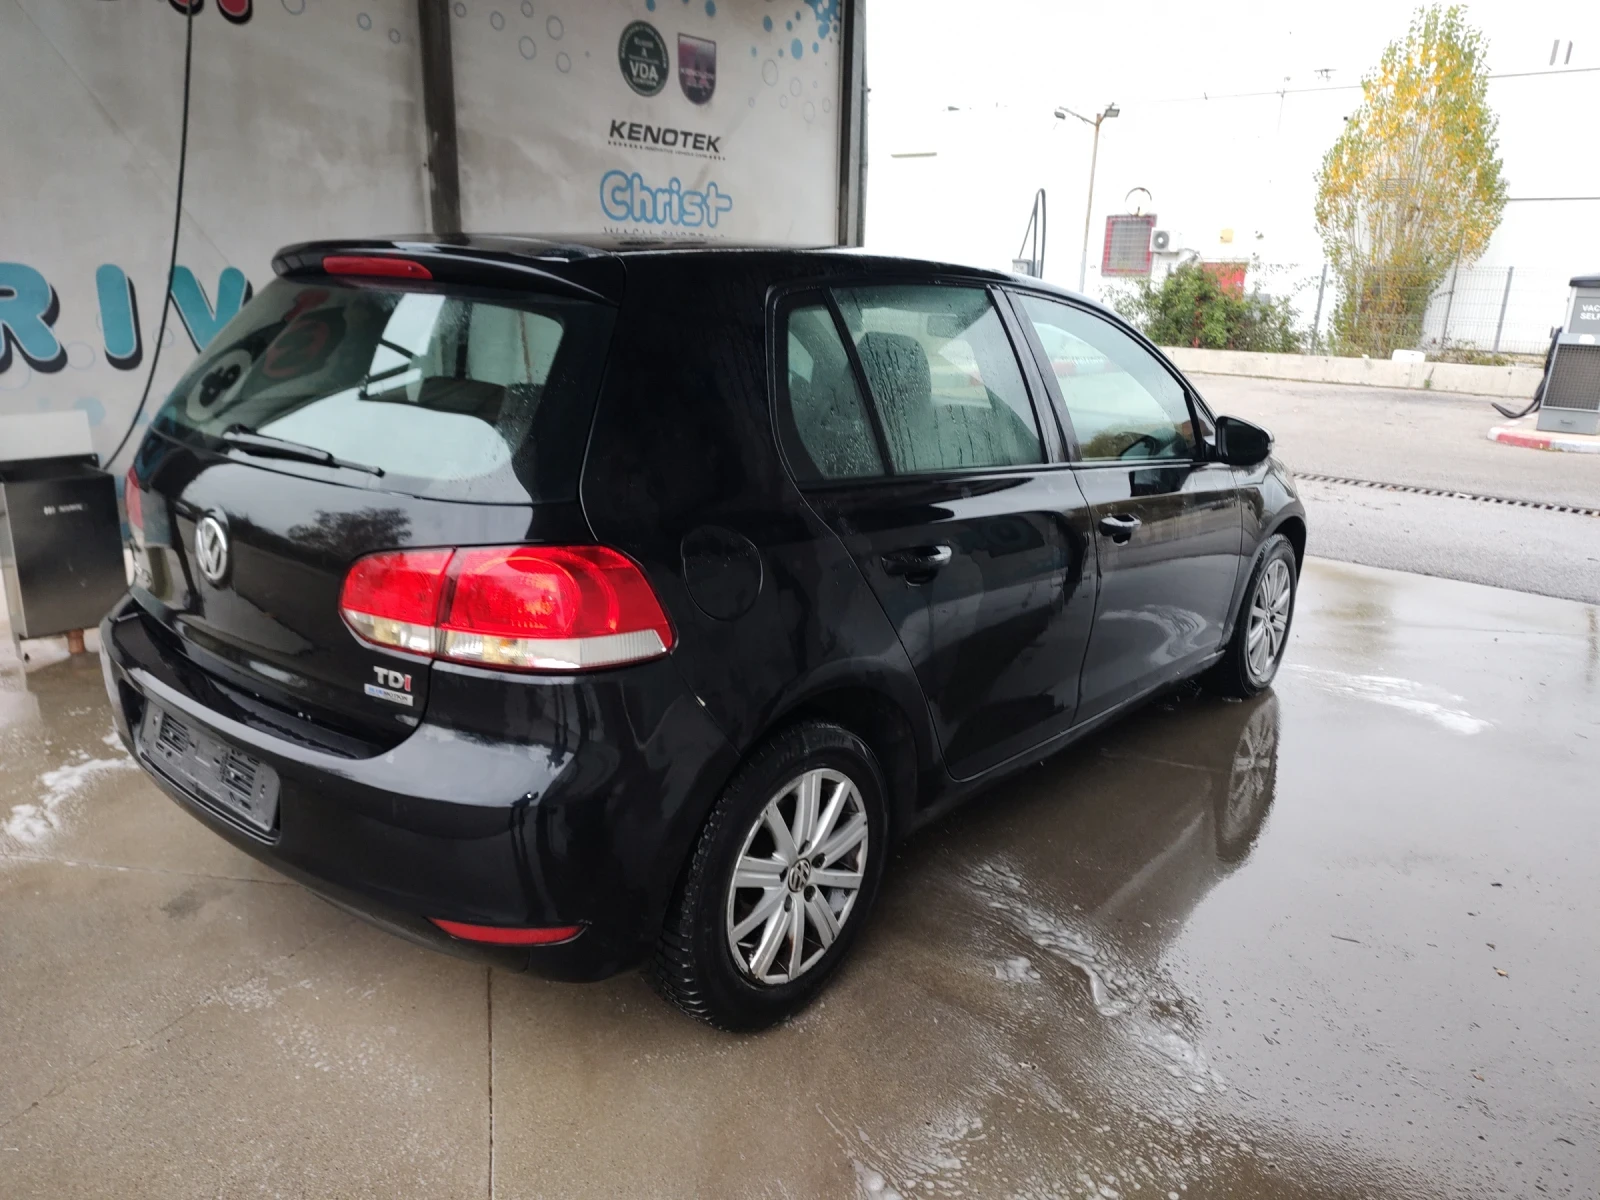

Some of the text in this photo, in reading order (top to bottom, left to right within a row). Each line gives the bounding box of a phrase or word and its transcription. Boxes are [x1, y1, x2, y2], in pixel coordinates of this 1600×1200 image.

[629, 60, 659, 81] VDA
[609, 119, 721, 153] KENOTEK
[600, 169, 733, 228] Christ
[373, 665, 412, 692] TDI
